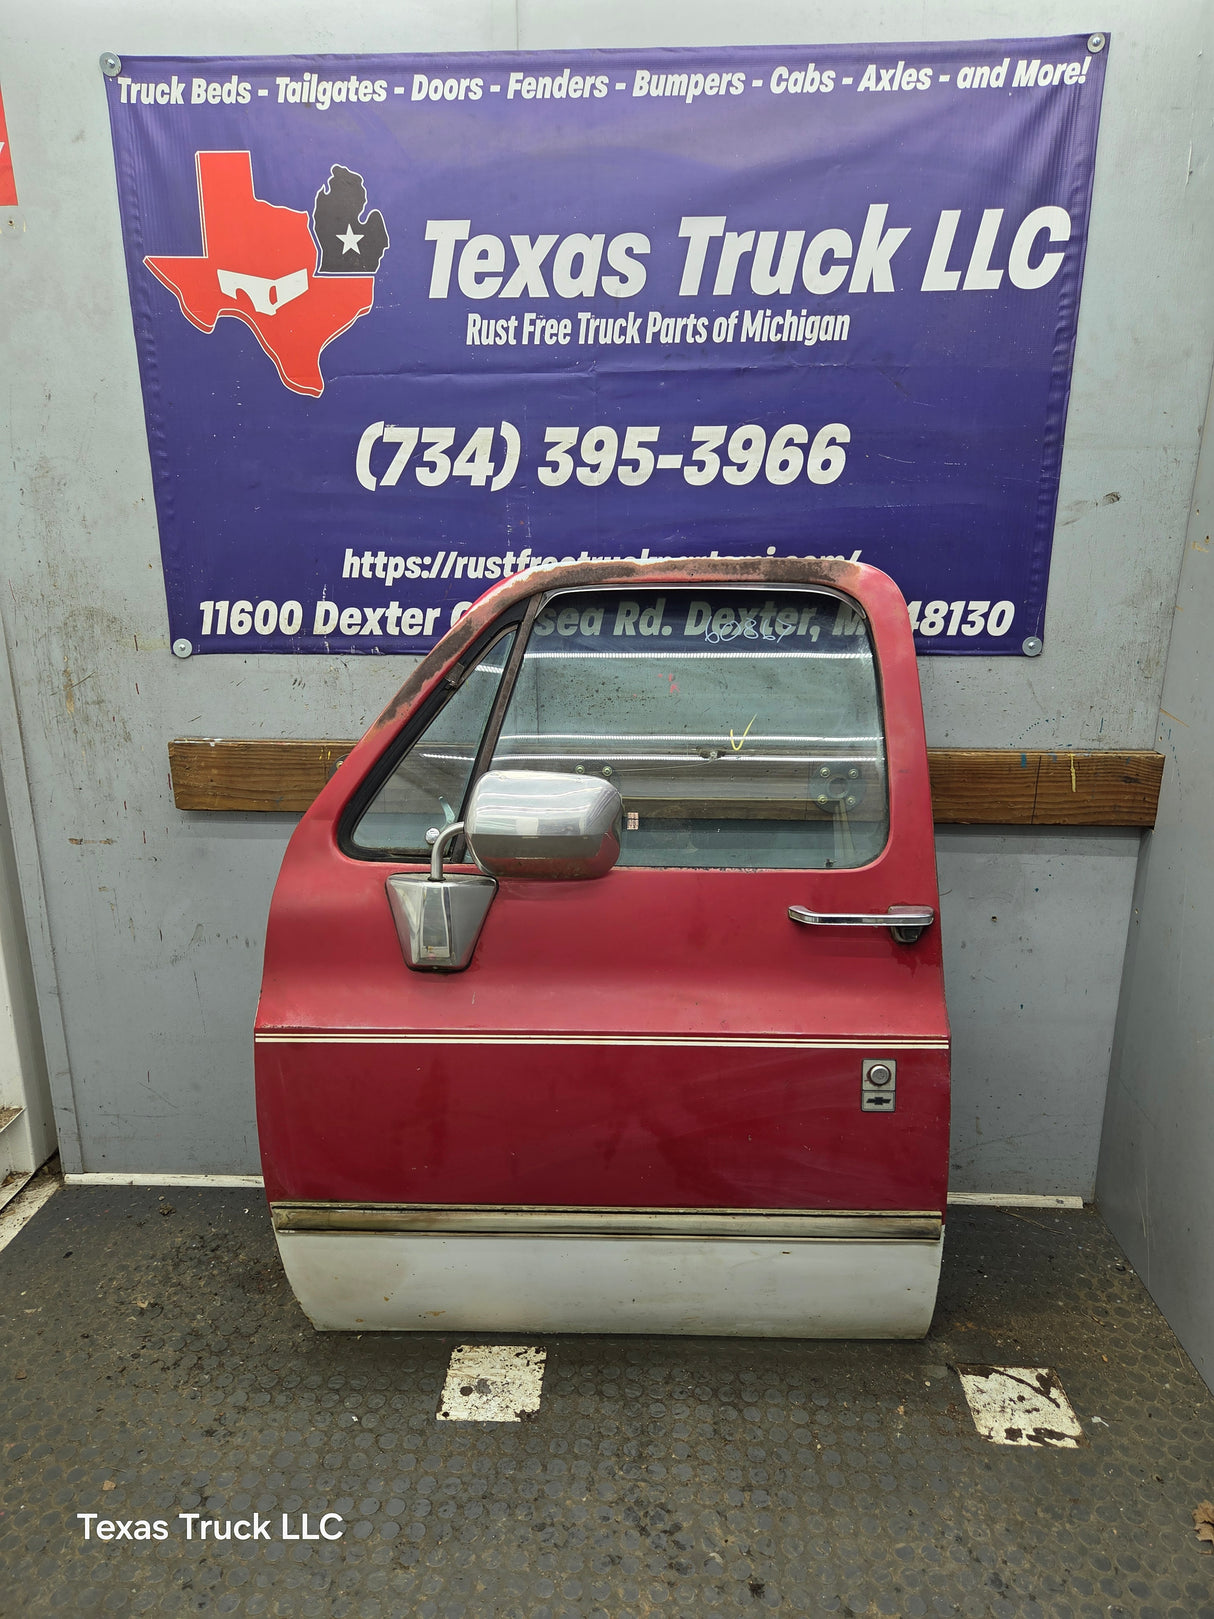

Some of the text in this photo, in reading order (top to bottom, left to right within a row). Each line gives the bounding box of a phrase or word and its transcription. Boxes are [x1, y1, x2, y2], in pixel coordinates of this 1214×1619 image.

[117, 75, 185, 105] Truck
[191, 75, 252, 105] Beds
[276, 72, 387, 111] Tailgates
[411, 74, 483, 101] Doors
[507, 68, 609, 100] Fenders
[632, 69, 745, 104] Bumpers
[770, 62, 836, 95] Cabs
[856, 60, 933, 92] Axles
[956, 57, 1010, 90] and
[1012, 55, 1092, 88] More!
[425, 203, 1072, 300] Texas Truck LLC
[466, 307, 851, 347] Rust Free Truck Parts of Michigan
[355, 420, 851, 492] (734) 395-3966
[199, 600, 303, 636] 11600
[312, 600, 442, 637] Dexter
[613, 597, 673, 637] Rd.
[684, 600, 821, 642] Dexter,
[904, 600, 1016, 637] 48130
